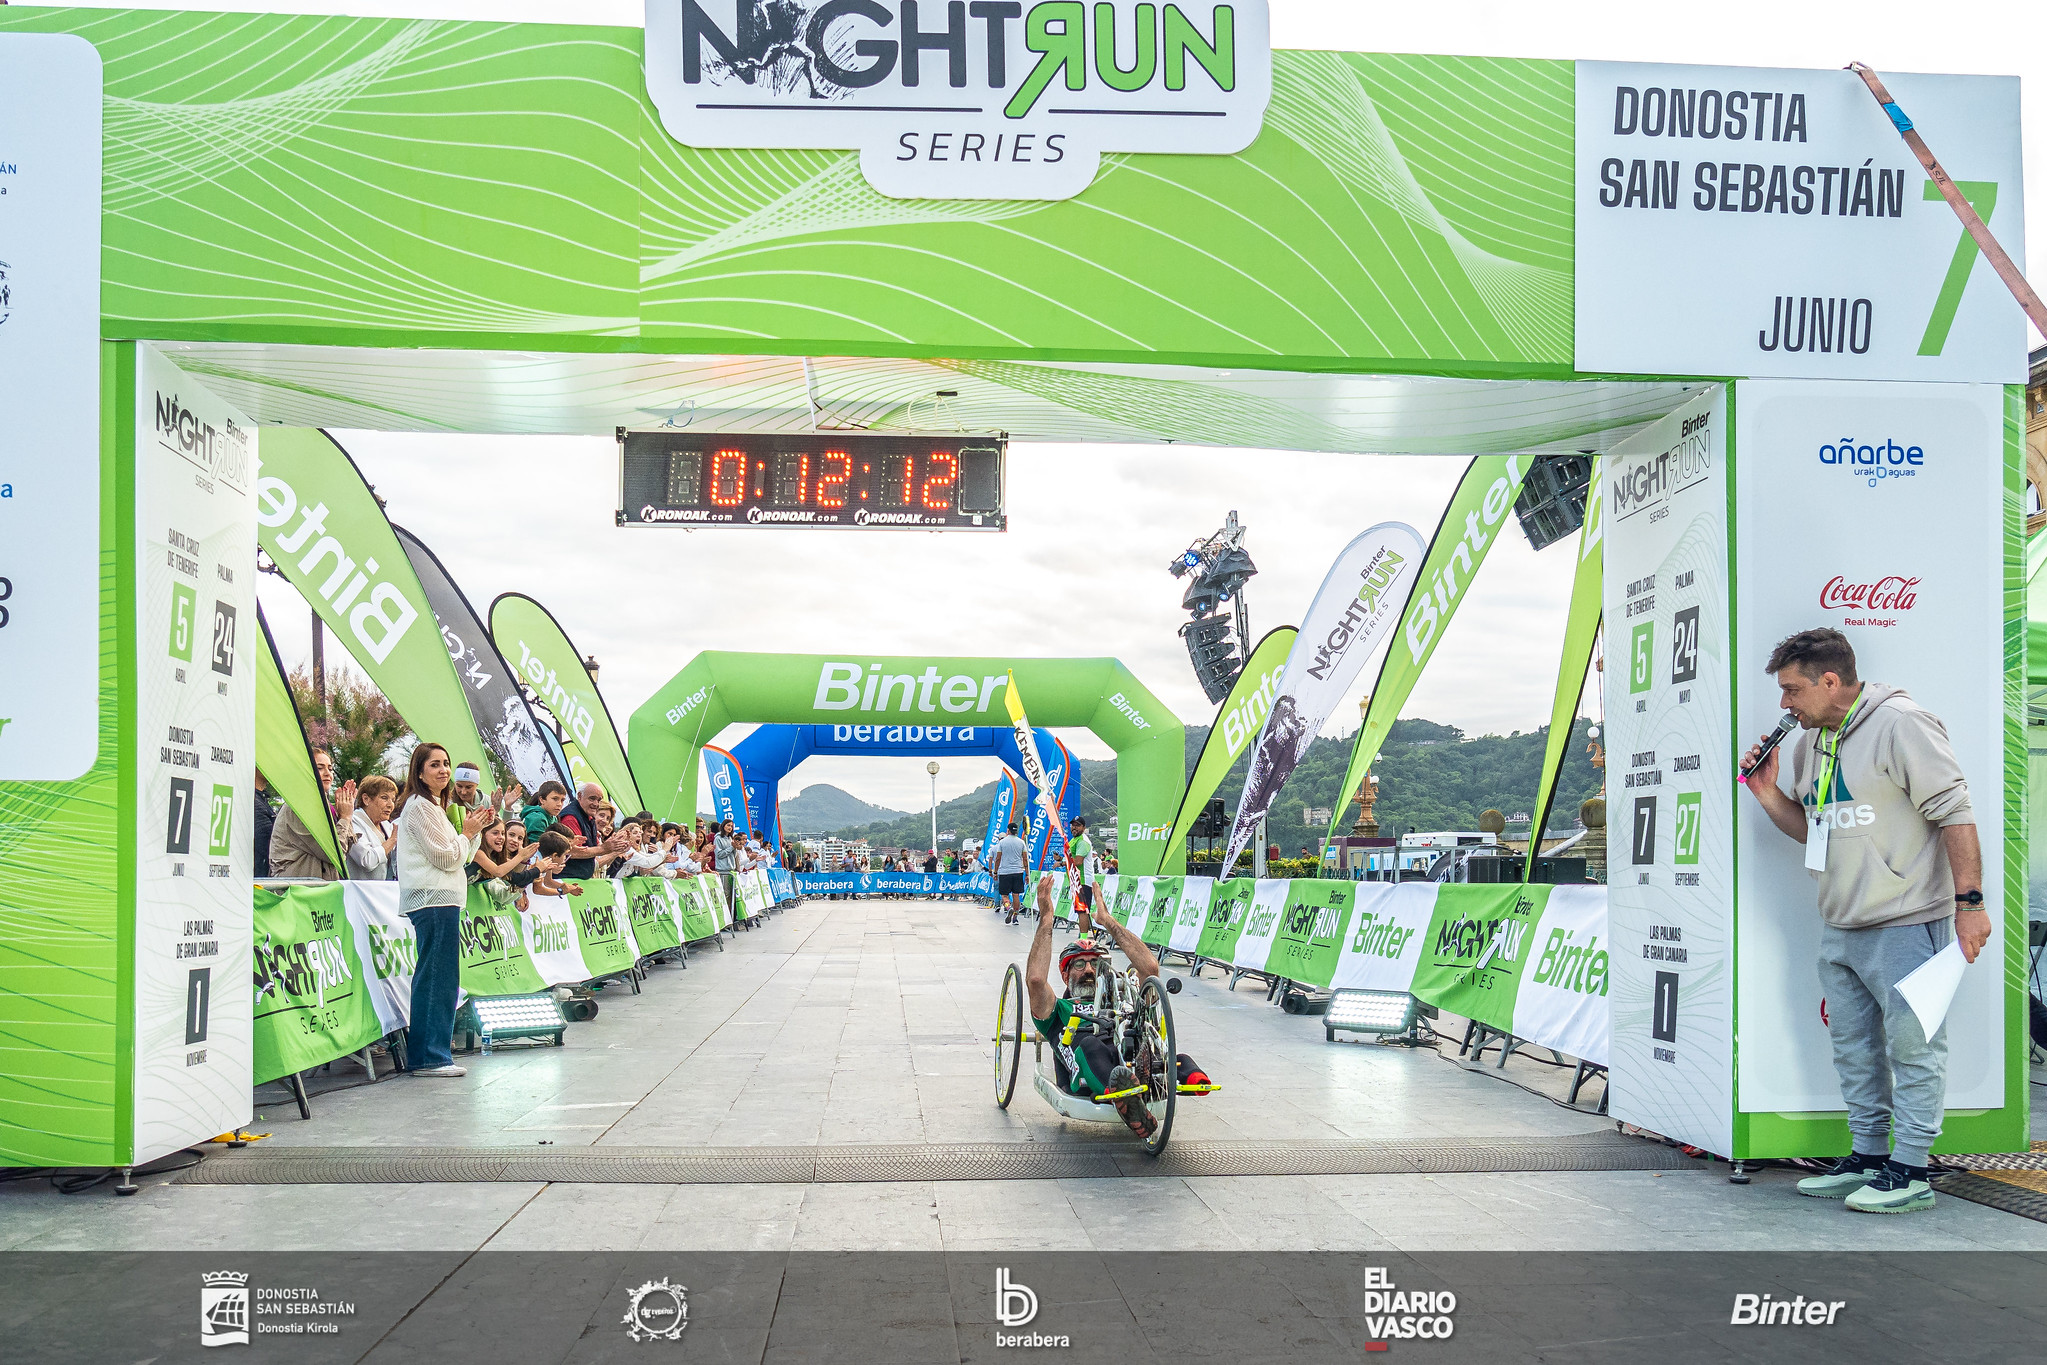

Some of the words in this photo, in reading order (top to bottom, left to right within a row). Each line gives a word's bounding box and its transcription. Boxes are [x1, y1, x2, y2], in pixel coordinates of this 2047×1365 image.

[1614, 86, 1807, 143] DONOSTIA
[897, 132, 1066, 163] SERIES
[1599, 157, 1677, 210] SAN
[1694, 157, 1905, 219] SEBASTIÁN
[1917, 180, 1998, 357] 7
[1758, 296, 1873, 355] JUNIO
[226, 417, 248, 447] Binter
[1682, 411, 1711, 438] Binter
[1819, 437, 1924, 466] añarbe
[195, 475, 214, 495] SERIES
[1854, 467, 1875, 476] urak
[1888, 468, 1916, 479] aguas
[1649, 506, 1669, 524] SERIES
[167, 550, 175, 568] DE
[186, 538, 200, 557] CRUZ
[1360, 545, 1386, 579] Binter
[217, 563, 234, 584] PALMA
[1626, 579, 1641, 598] SANTA
[1642, 574, 1656, 593] CRUZ
[1675, 570, 1694, 591] PALMA
[1626, 603, 1632, 618] DE
[1633, 595, 1655, 616] TENERIFE
[1819, 575, 1923, 610] Coca-Cola
[176, 595, 190, 651] 5
[1360, 602, 1389, 642] SERIES
[1844, 617, 1866, 626] Real
[1867, 617, 1897, 628] Magic
[213, 611, 234, 667] 24
[1673, 618, 1697, 675] 24
[1636, 633, 1647, 684] 5
[813, 662, 1009, 713] Binter
[665, 686, 708, 726] Binter
[1108, 692, 1151, 731] Binter
[1223, 660, 1287, 758] Binte
[169, 725, 194, 747] DONOSTIA
[160, 747, 172, 764] SAN
[211, 746, 234, 765] ZARAGOZA
[1631, 750, 1656, 768] DONOSTIA
[1673, 754, 1701, 773] ZARAGOZA
[1624, 773, 1635, 788] SAN
[175, 789, 187, 844] 7
[210, 795, 232, 848] 27
[1675, 803, 1700, 856] 27
[1640, 807, 1650, 856] 7
[805, 879, 854, 890] berabera
[876, 878, 921, 890] berabera
[1329, 890, 1347, 904] Binter
[183, 920, 194, 936] LAS
[194, 920, 214, 936] PALMAS
[311, 910, 335, 933] Binter
[531, 913, 570, 954] Binter
[1249, 904, 1277, 937] Binter
[1649, 925, 1659, 940] LAS
[1660, 926, 1682, 942] PALMAS
[176, 943, 183, 959] DE
[184, 942, 198, 958] GRAN
[1352, 912, 1415, 960] Binter
[1643, 944, 1650, 959] DE
[1650, 945, 1665, 961] GRAN
[1665, 946, 1688, 963] CANARIA
[194, 980, 202, 1034] 1
[1662, 982, 1669, 1033] 1
